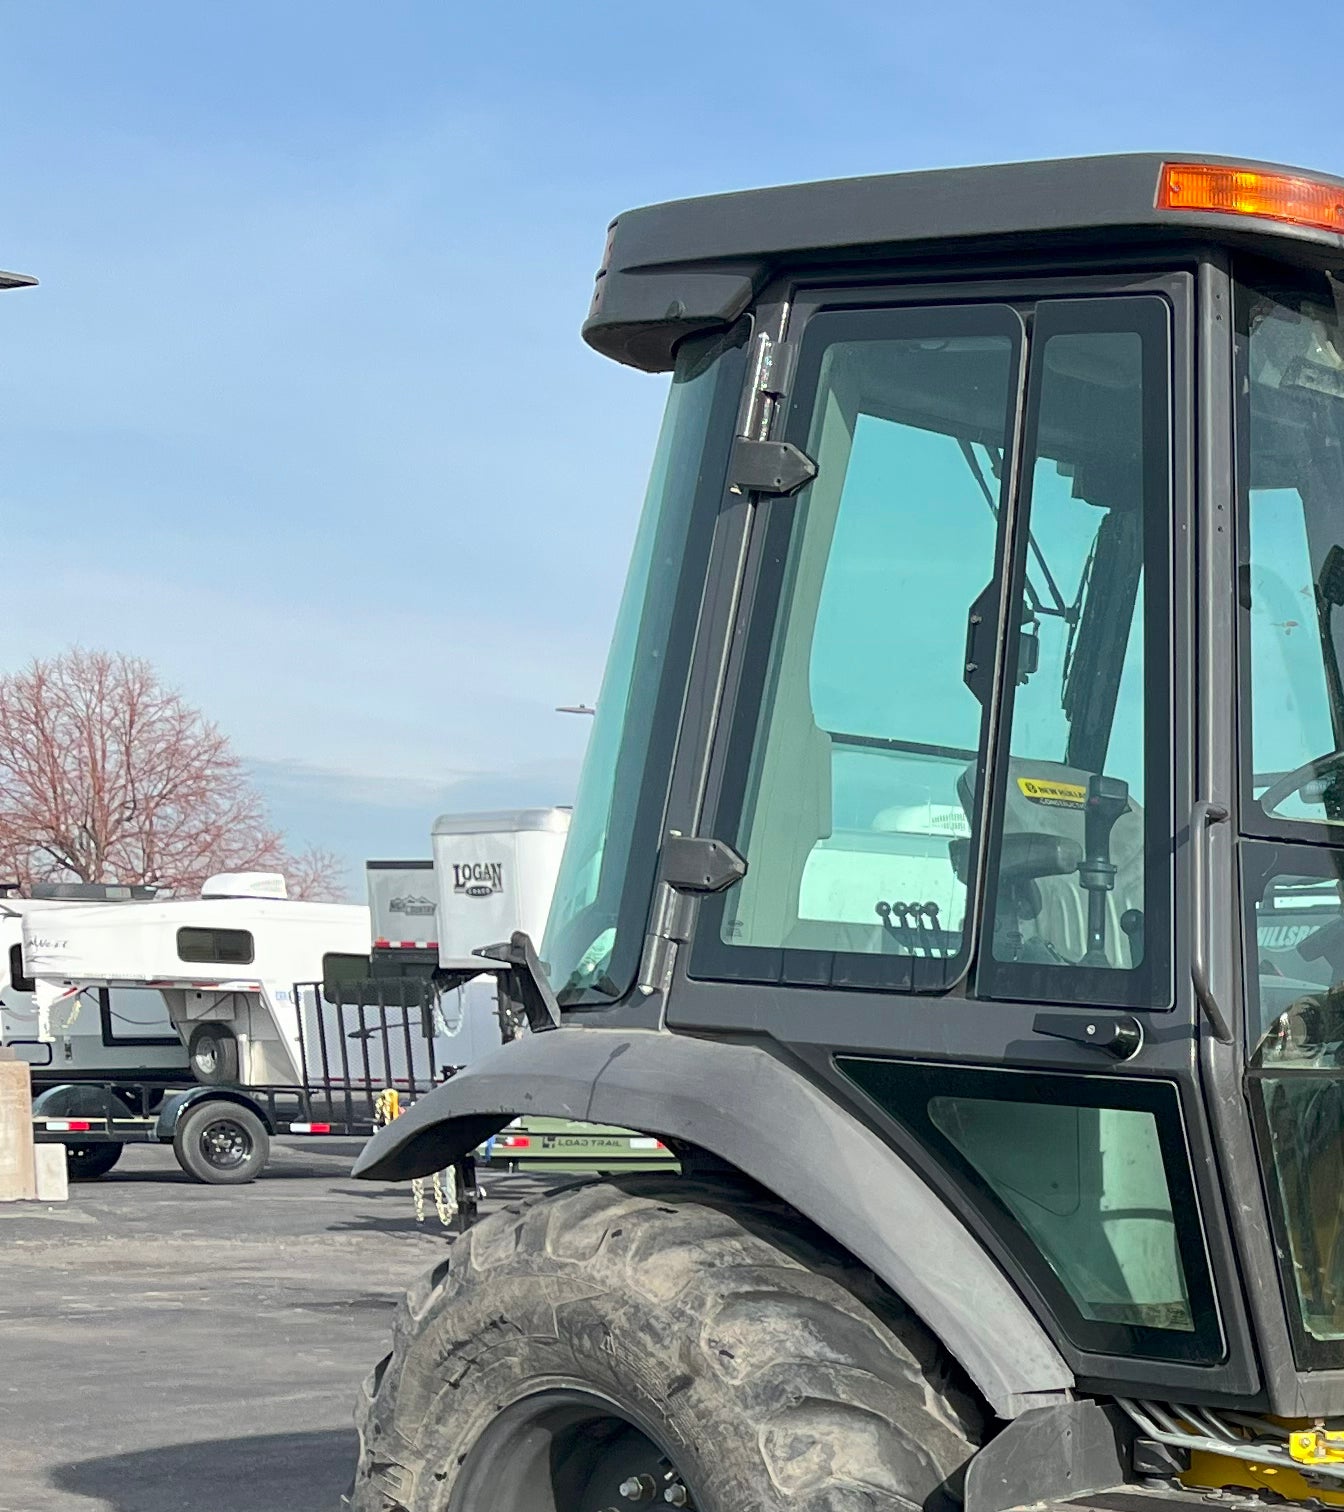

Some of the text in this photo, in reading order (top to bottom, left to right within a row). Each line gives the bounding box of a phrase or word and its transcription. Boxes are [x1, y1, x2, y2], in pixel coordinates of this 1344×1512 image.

[453, 863, 502, 888] LOGAN
[558, 1139, 623, 1148] LOAD TRAIL
